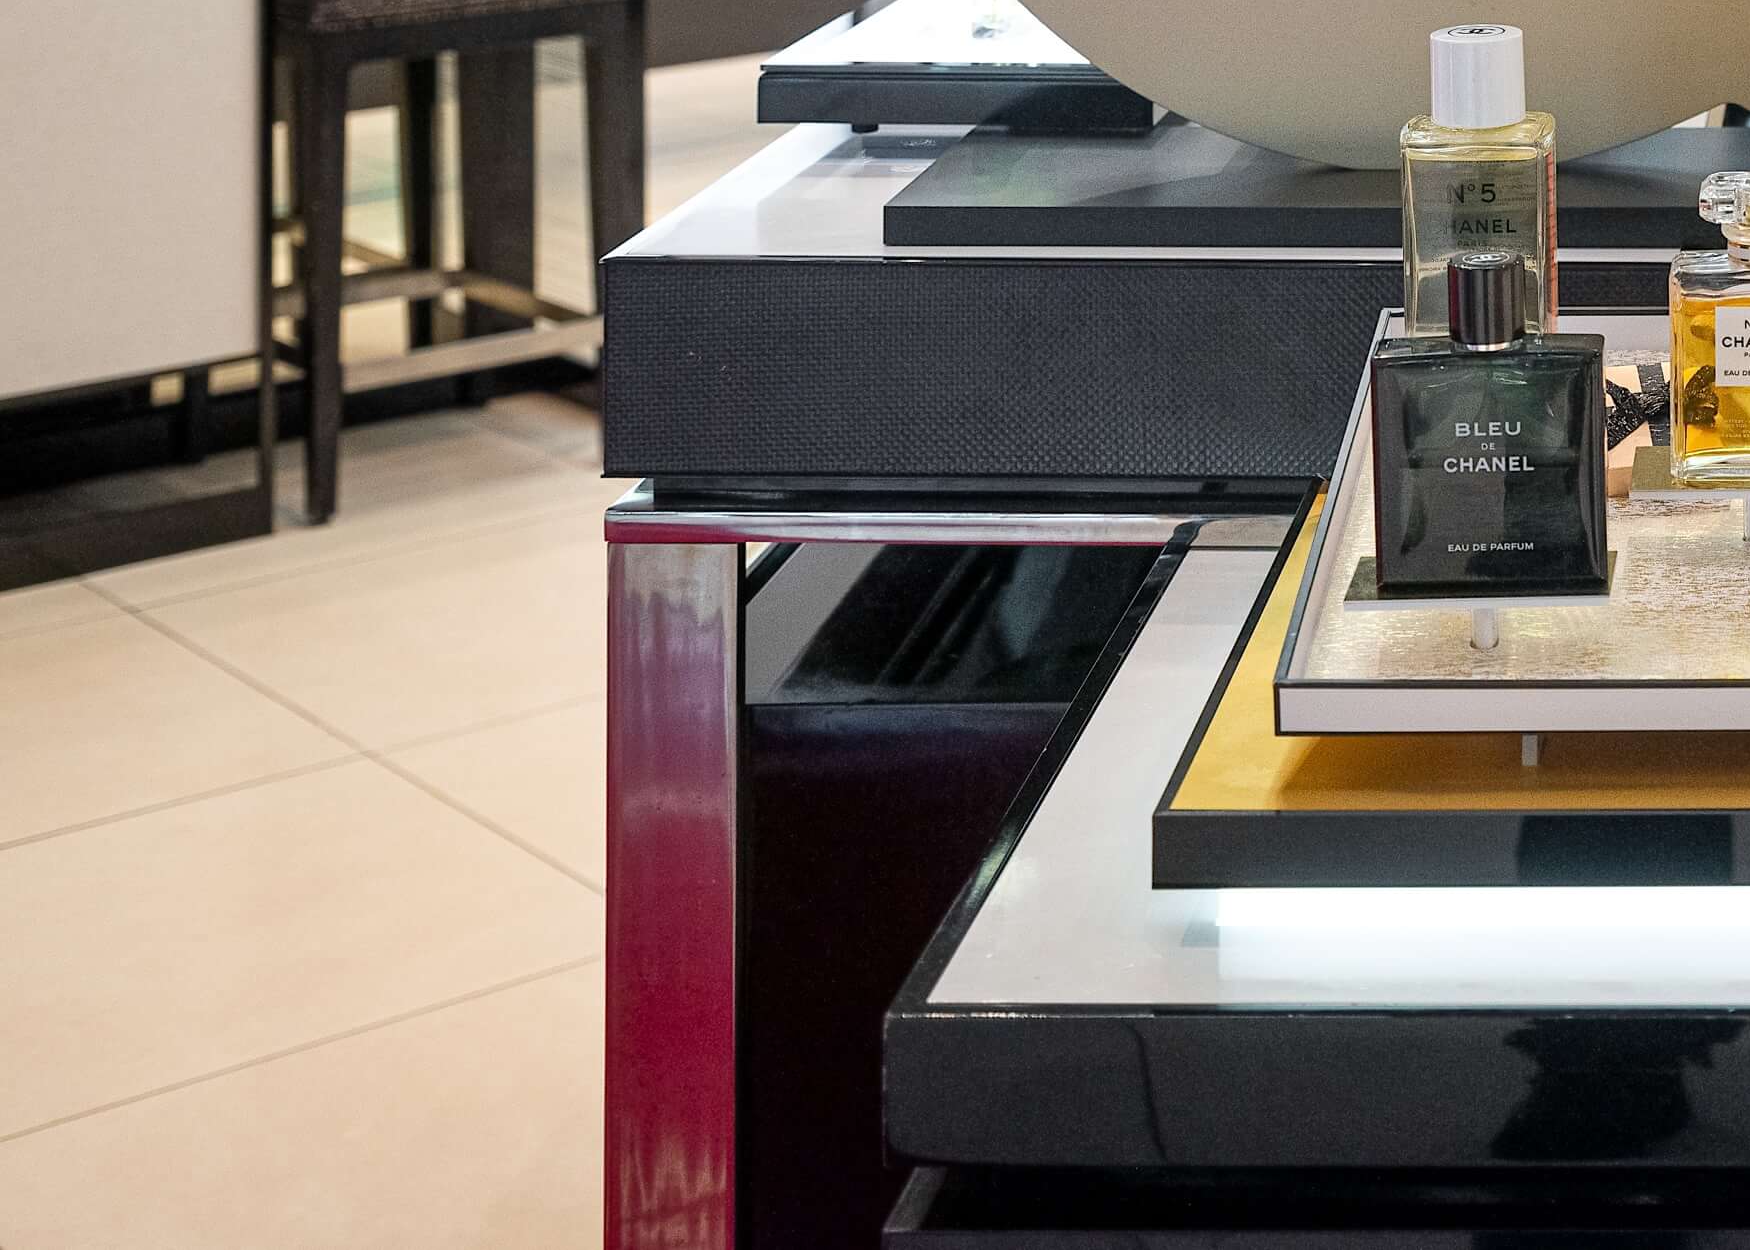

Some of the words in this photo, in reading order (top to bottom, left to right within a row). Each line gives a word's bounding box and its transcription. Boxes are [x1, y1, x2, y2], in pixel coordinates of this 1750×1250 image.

[1454, 421, 1521, 438] BLEU
[1480, 442, 1497, 451] DE
[1443, 455, 1536, 474] CHANEL
[1447, 543, 1469, 553] EAU
[1472, 543, 1487, 552] DE
[1490, 541, 1534, 552] PARFUM
